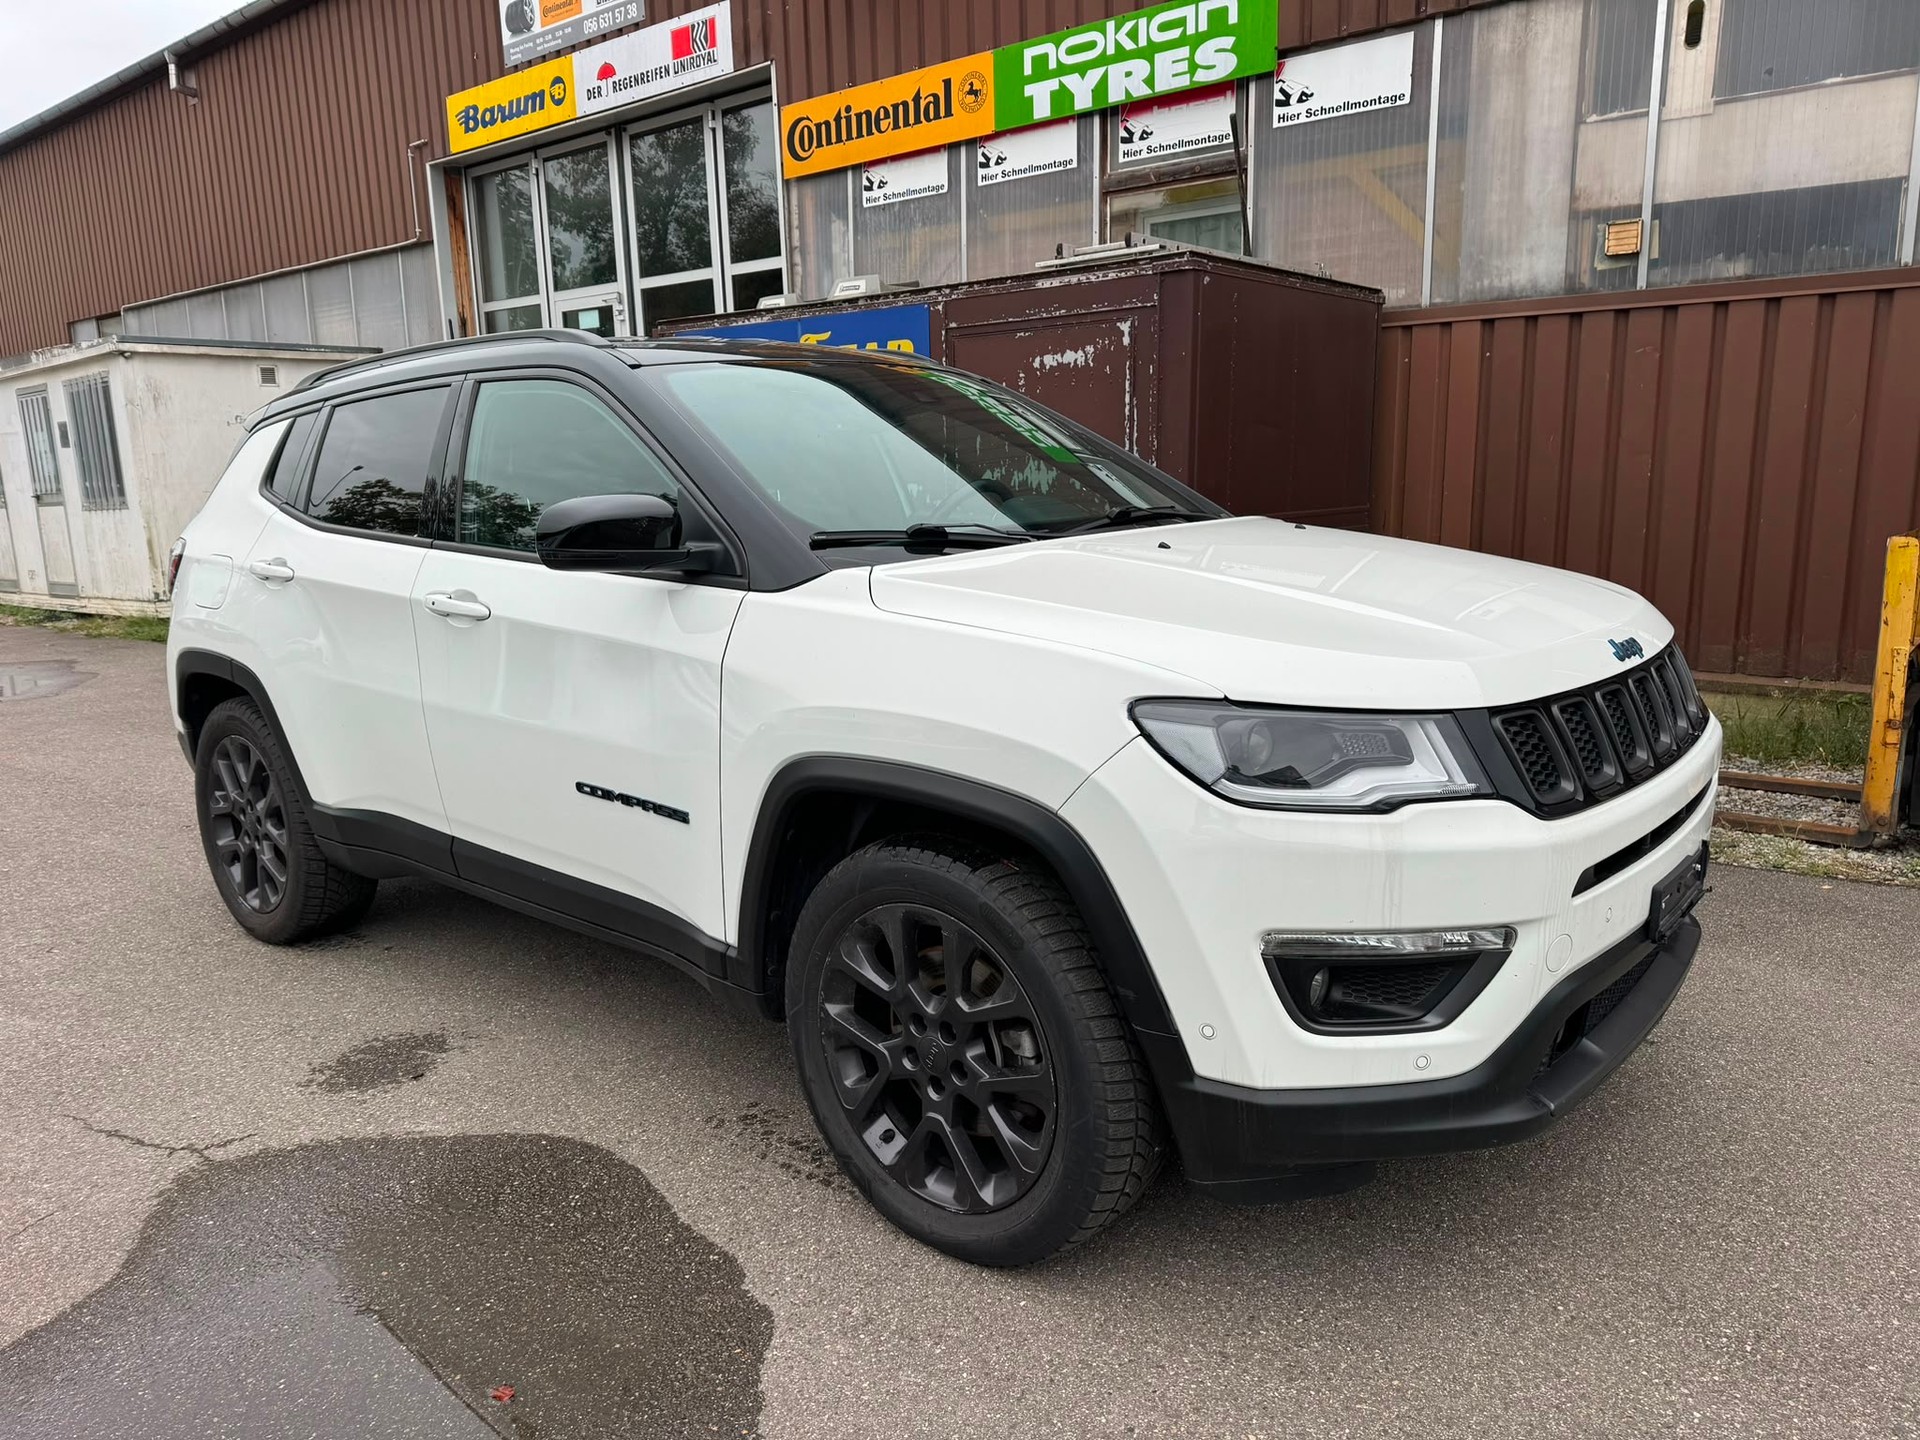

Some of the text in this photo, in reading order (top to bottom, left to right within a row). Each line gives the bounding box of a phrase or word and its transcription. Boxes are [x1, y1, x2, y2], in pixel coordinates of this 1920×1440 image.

[583, 2, 638, 34] 056 631 57 38
[586, 50, 718, 101] DER REGENREIFEN UNIROYAL
[1024, 36, 1238, 120] TYRES
[455, 89, 545, 134] Barum
[787, 78, 954, 162] Continental
[1277, 92, 1406, 124] Hier Schnellmontage
[1122, 132, 1231, 159] Hier Schnellmontage
[981, 158, 1074, 183] Hier Schnellmontage
[865, 183, 945, 205] Hier Schnellmontage
[1607, 636, 1645, 662] Jeep
[575, 781, 690, 825] COMPASS
